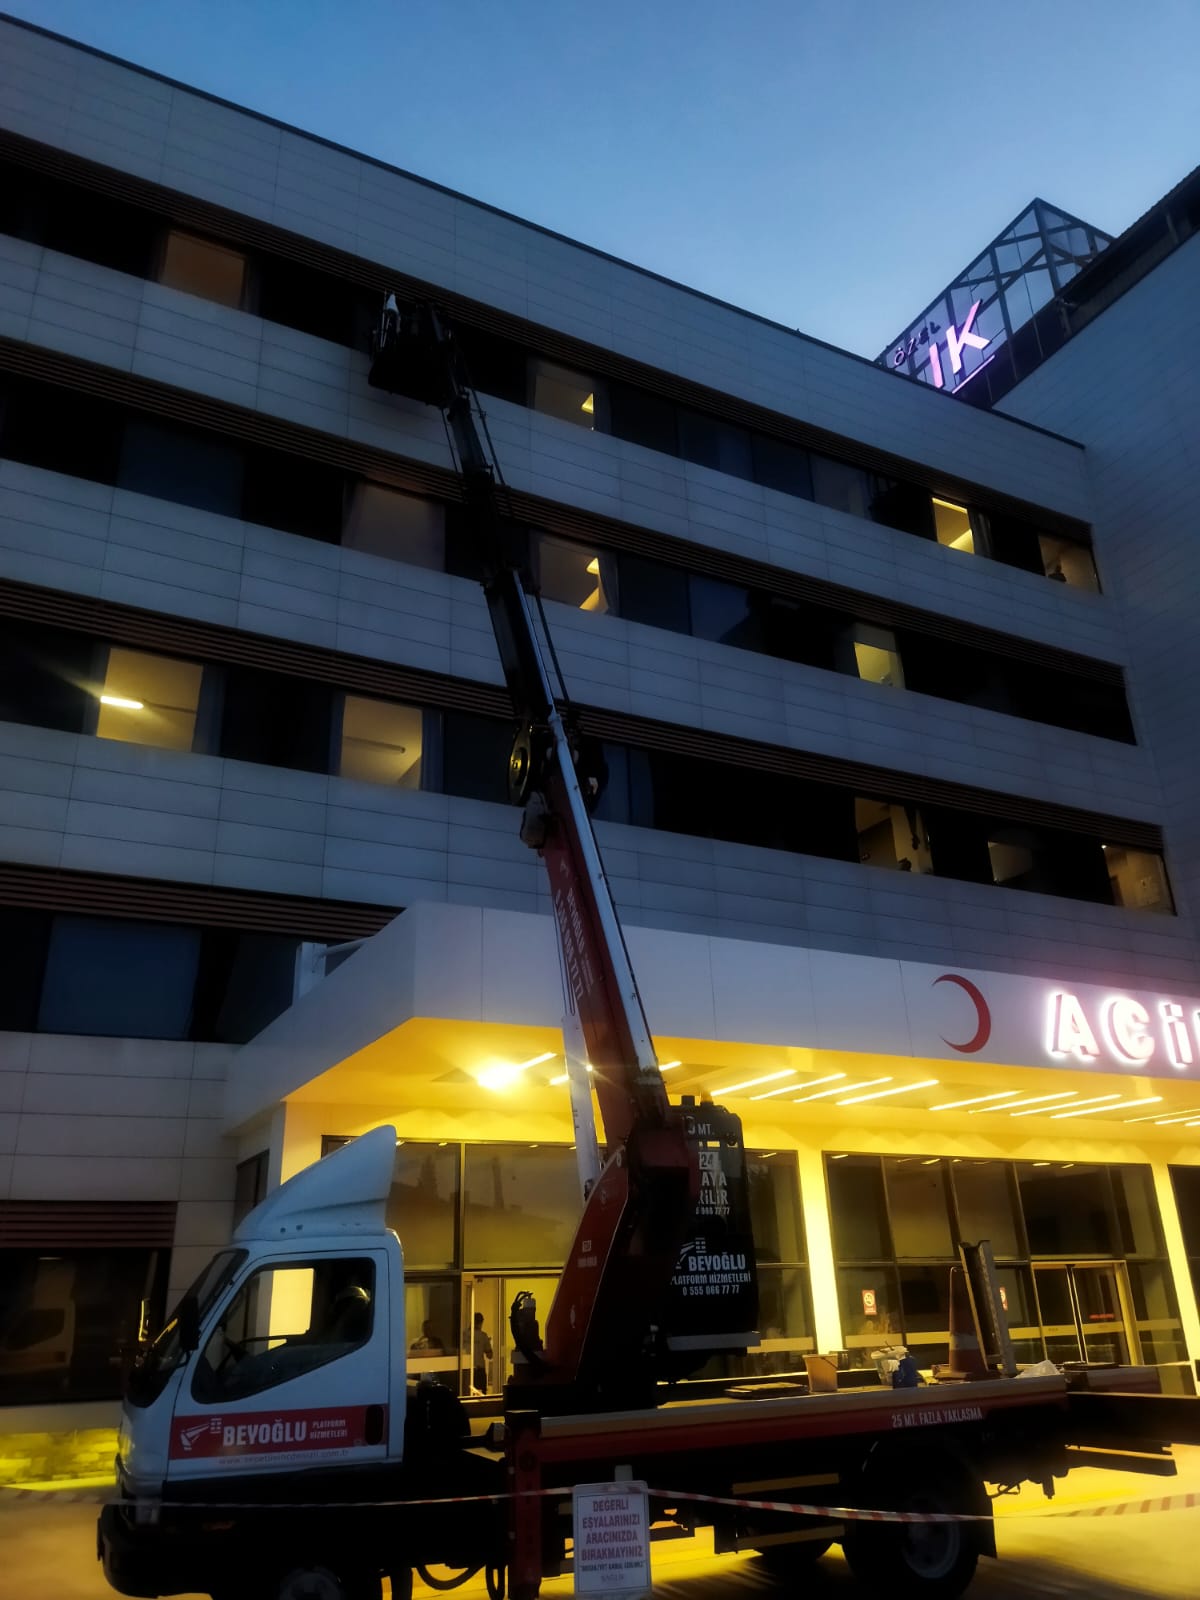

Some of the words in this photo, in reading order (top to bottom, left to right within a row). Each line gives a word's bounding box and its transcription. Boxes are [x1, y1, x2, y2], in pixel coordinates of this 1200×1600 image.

[1047, 990, 1200, 1067] ACİ
[702, 1171, 727, 1187] AYA
[688, 1251, 746, 1272] BEYOĞLU
[670, 1273, 708, 1286] PLATFORM
[682, 1286, 688, 1297] 0
[689, 1285, 704, 1297] 555
[721, 1284, 730, 1296] 77
[731, 1284, 740, 1295] 77
[312, 1419, 346, 1429] PLATFORM
[891, 1413, 903, 1429] 25
[919, 1410, 943, 1425] FAZLA
[222, 1418, 307, 1448] BEYOĞLU
[592, 1497, 629, 1513] DEĞERLİ
[582, 1513, 640, 1530] EŞYALARINIZI
[585, 1529, 638, 1545] ARACINIZDA
